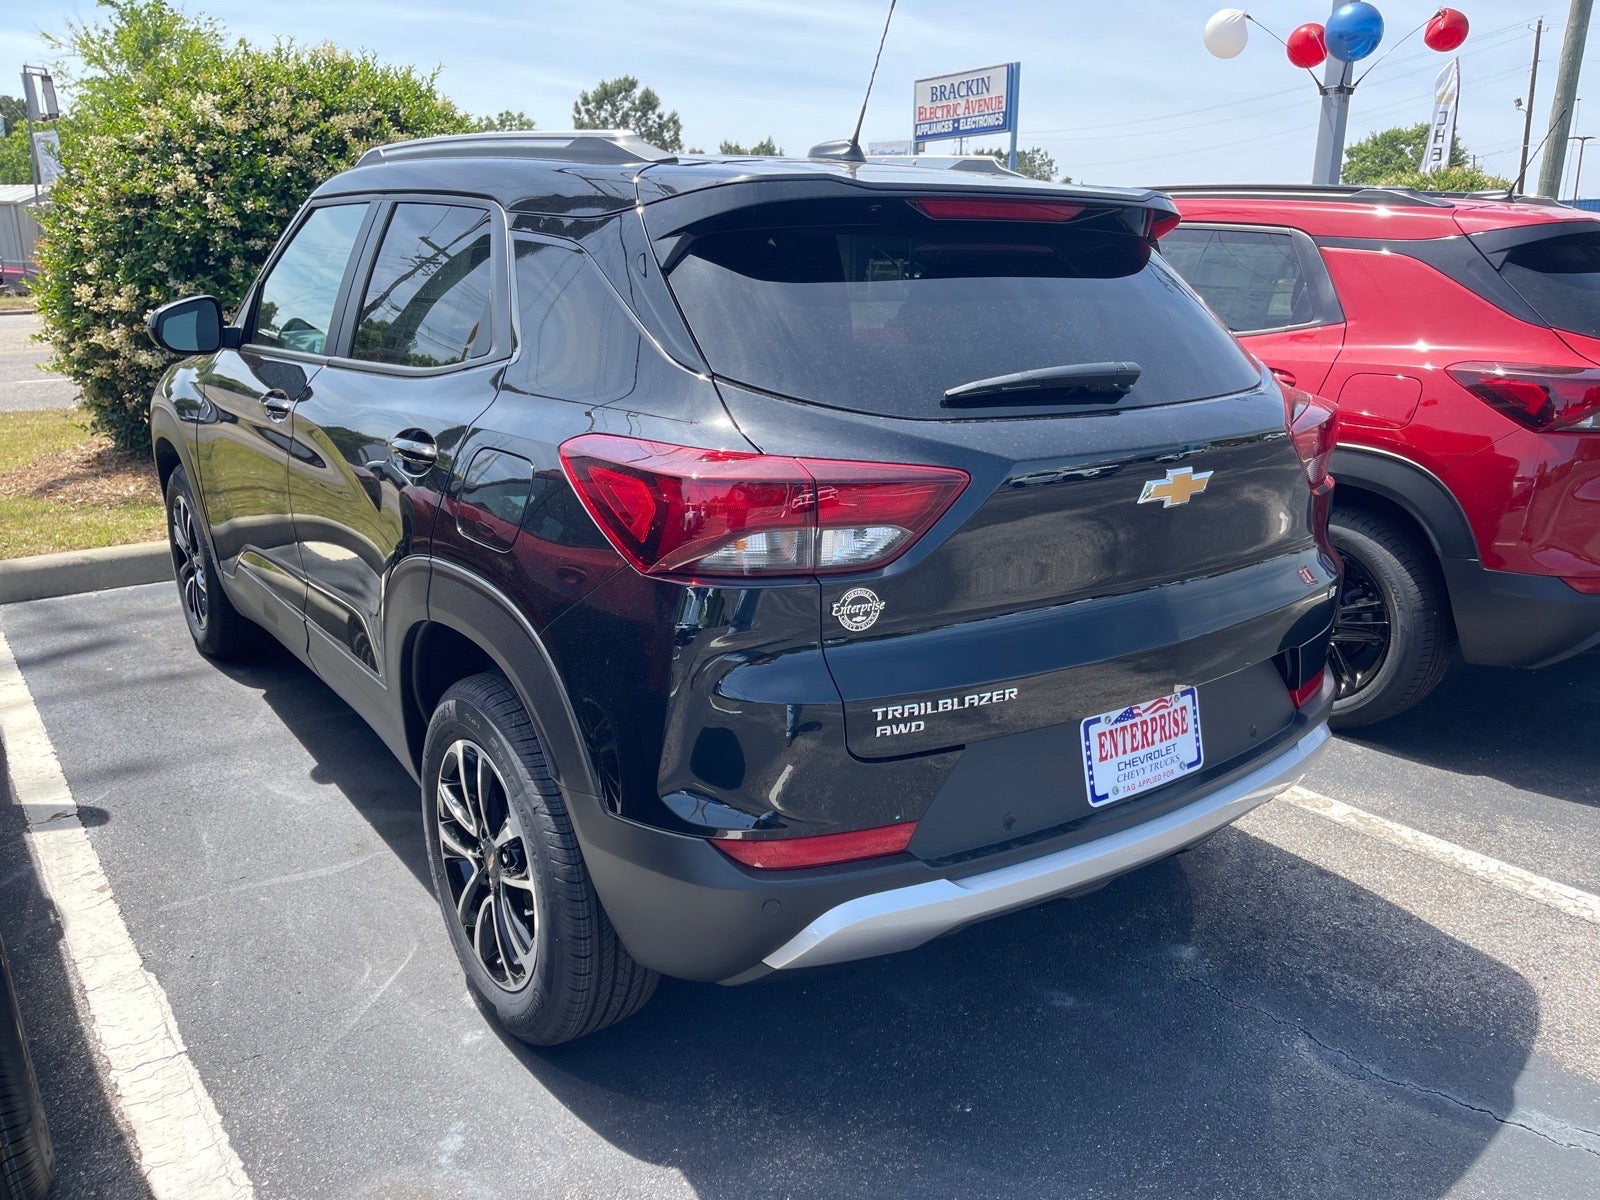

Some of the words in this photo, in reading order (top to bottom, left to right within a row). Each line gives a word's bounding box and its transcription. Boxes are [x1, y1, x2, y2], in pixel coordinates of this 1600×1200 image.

[930, 76, 991, 102] BRACKIN
[918, 102, 961, 122] ELECTRIC
[963, 95, 1003, 116] AVENUE
[916, 120, 954, 136] APPLIANCES
[959, 112, 1003, 130] ELECTRONICS
[832, 600, 886, 617] Enterprise
[872, 687, 1018, 721] TRAILBLAZER
[875, 720, 925, 738] AWD
[1097, 705, 1189, 763] ENTERPRISE
[1116, 767, 1147, 784] CHEVY
[1149, 753, 1181, 774] TRUCKS
[1117, 742, 1178, 772] CHEVROLET
[1122, 784, 1136, 793] TAG
[1138, 773, 1162, 788] APPLIED
[1163, 769, 1175, 781] FOR
